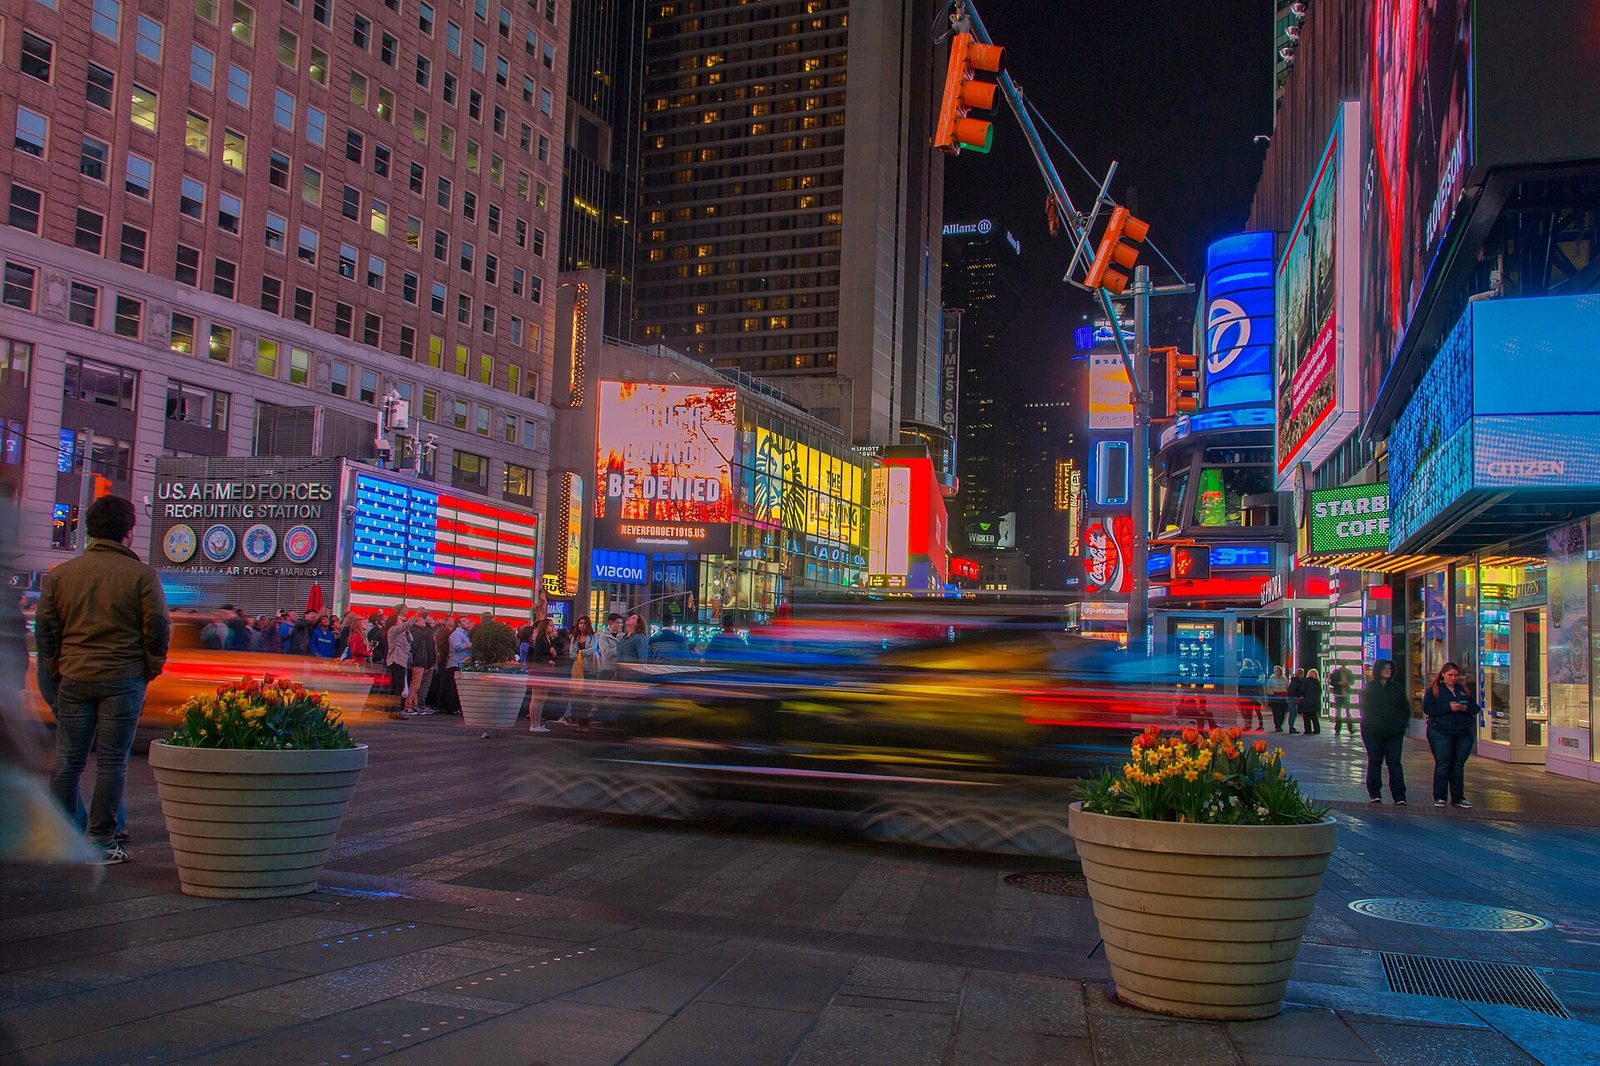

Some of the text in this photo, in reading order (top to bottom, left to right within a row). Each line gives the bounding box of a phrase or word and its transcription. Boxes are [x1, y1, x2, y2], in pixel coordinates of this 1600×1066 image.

[943, 224, 976, 235] Allianz
[944, 328, 957, 391] TIMES
[1487, 461, 1565, 477] CITIZEN
[826, 470, 841, 489] THE
[159, 483, 332, 500] U.S. ARMED FORCES
[609, 474, 720, 502] BE DENIED
[165, 504, 321, 519] RECRUITING STATION
[621, 525, 705, 538] NEVERFORGET1915.US
[968, 533, 995, 542] WICKED
[191, 566, 217, 574] NAVY
[243, 567, 273, 576] FORCE
[280, 567, 318, 577] MARINES
